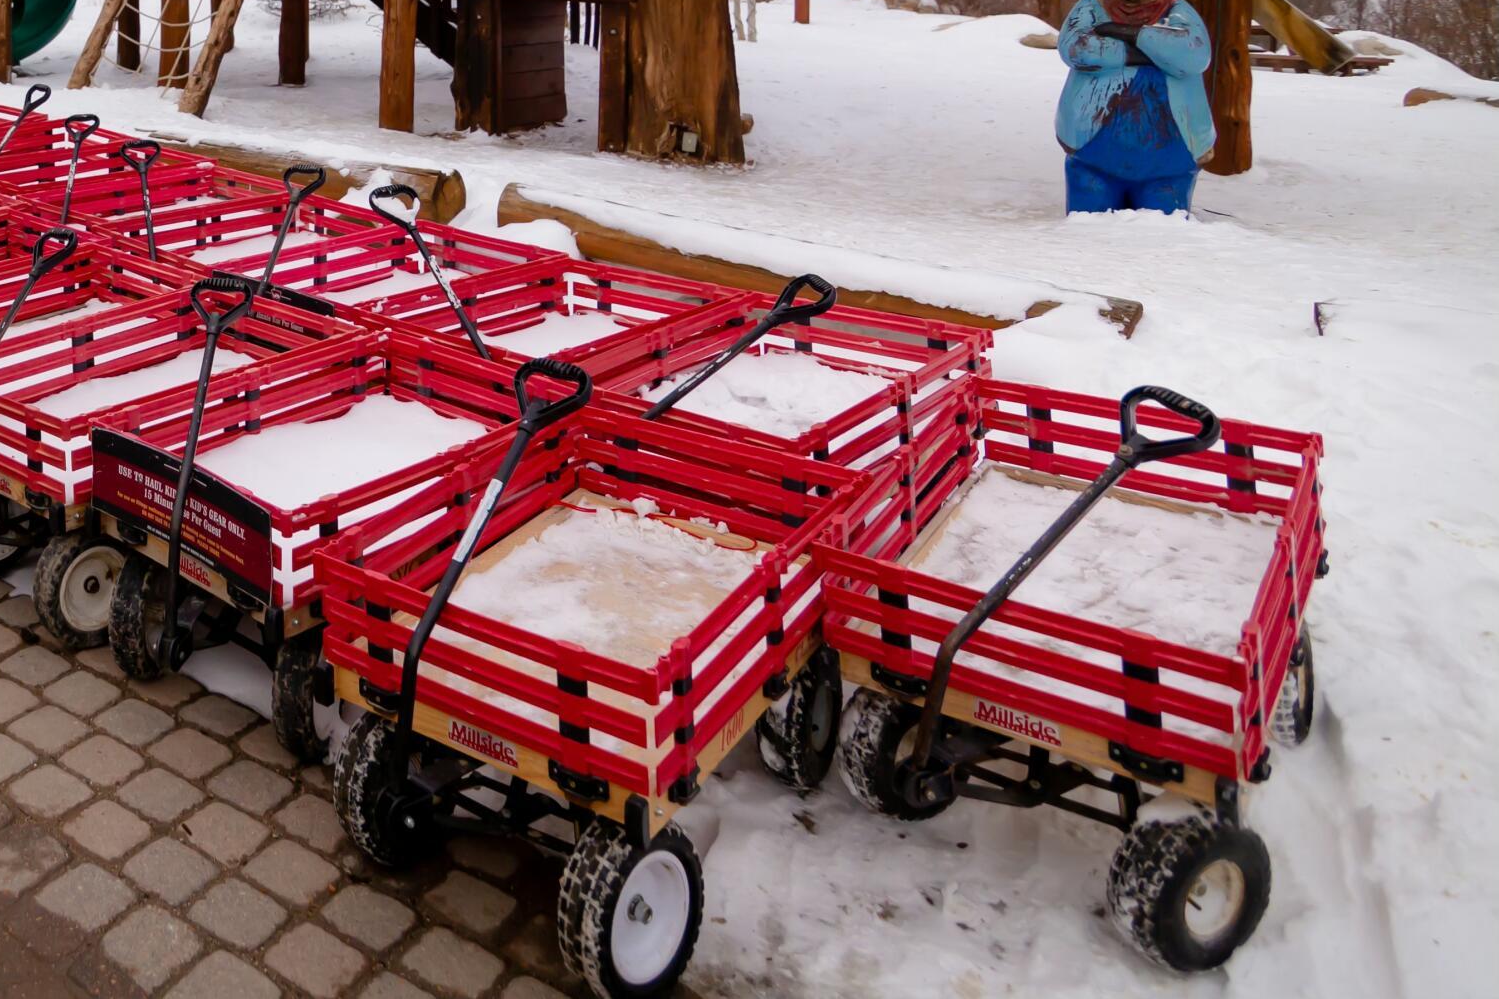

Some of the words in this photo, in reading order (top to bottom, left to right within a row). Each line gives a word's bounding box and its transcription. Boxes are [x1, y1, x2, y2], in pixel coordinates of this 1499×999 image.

[118, 465, 132, 480] USE
[134, 470, 143, 482] TO
[145, 476, 164, 493] HAUL
[190, 498, 208, 516] KID'S
[209, 507, 226, 528] GEAR
[228, 521, 246, 540] ONLY.
[144, 488, 152, 501] 15
[154, 493, 173, 511] Minut
[191, 513, 203, 527] Per
[203, 518, 222, 539] Guest
[180, 556, 208, 581] illside
[451, 721, 515, 761] Millside
[720, 706, 744, 753] 1600
[977, 701, 1058, 740] Millside
